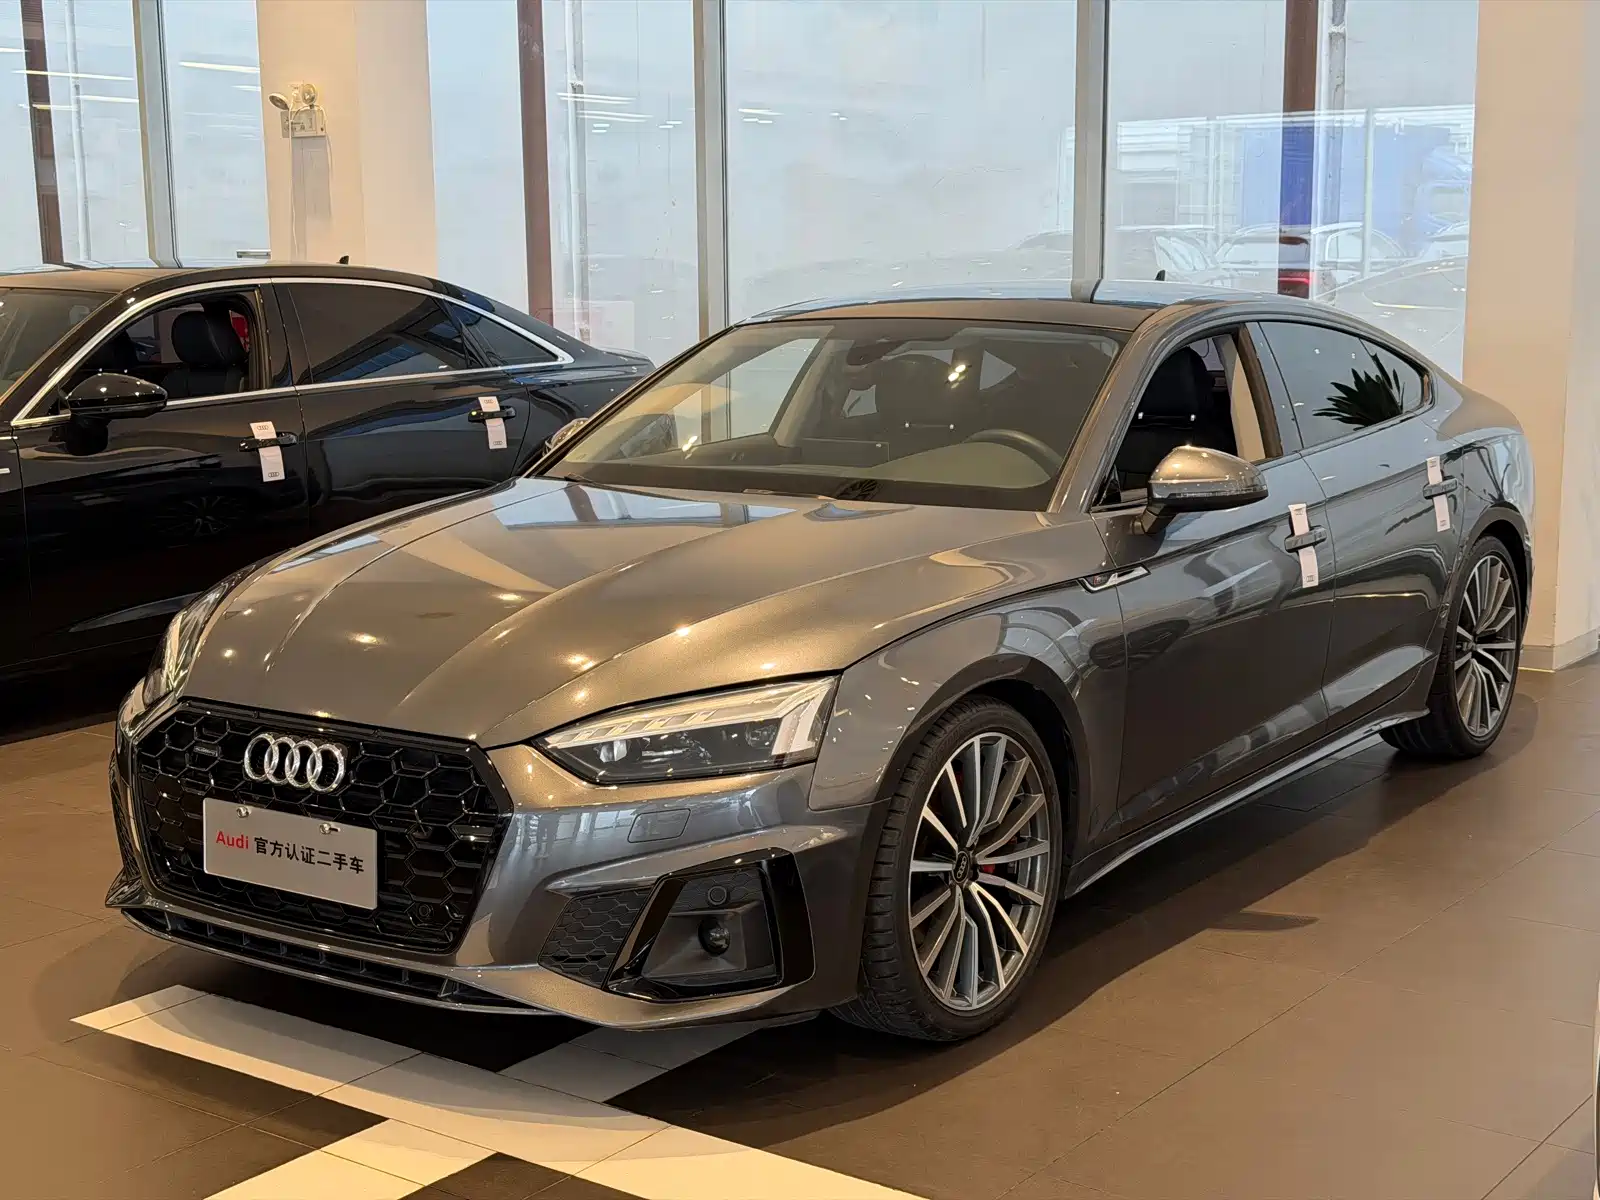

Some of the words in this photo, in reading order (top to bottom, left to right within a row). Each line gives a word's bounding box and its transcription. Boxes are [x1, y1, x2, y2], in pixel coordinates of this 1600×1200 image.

[215, 830, 249, 849] Audi
[254, 837, 365, 874] 官方认证二手车
